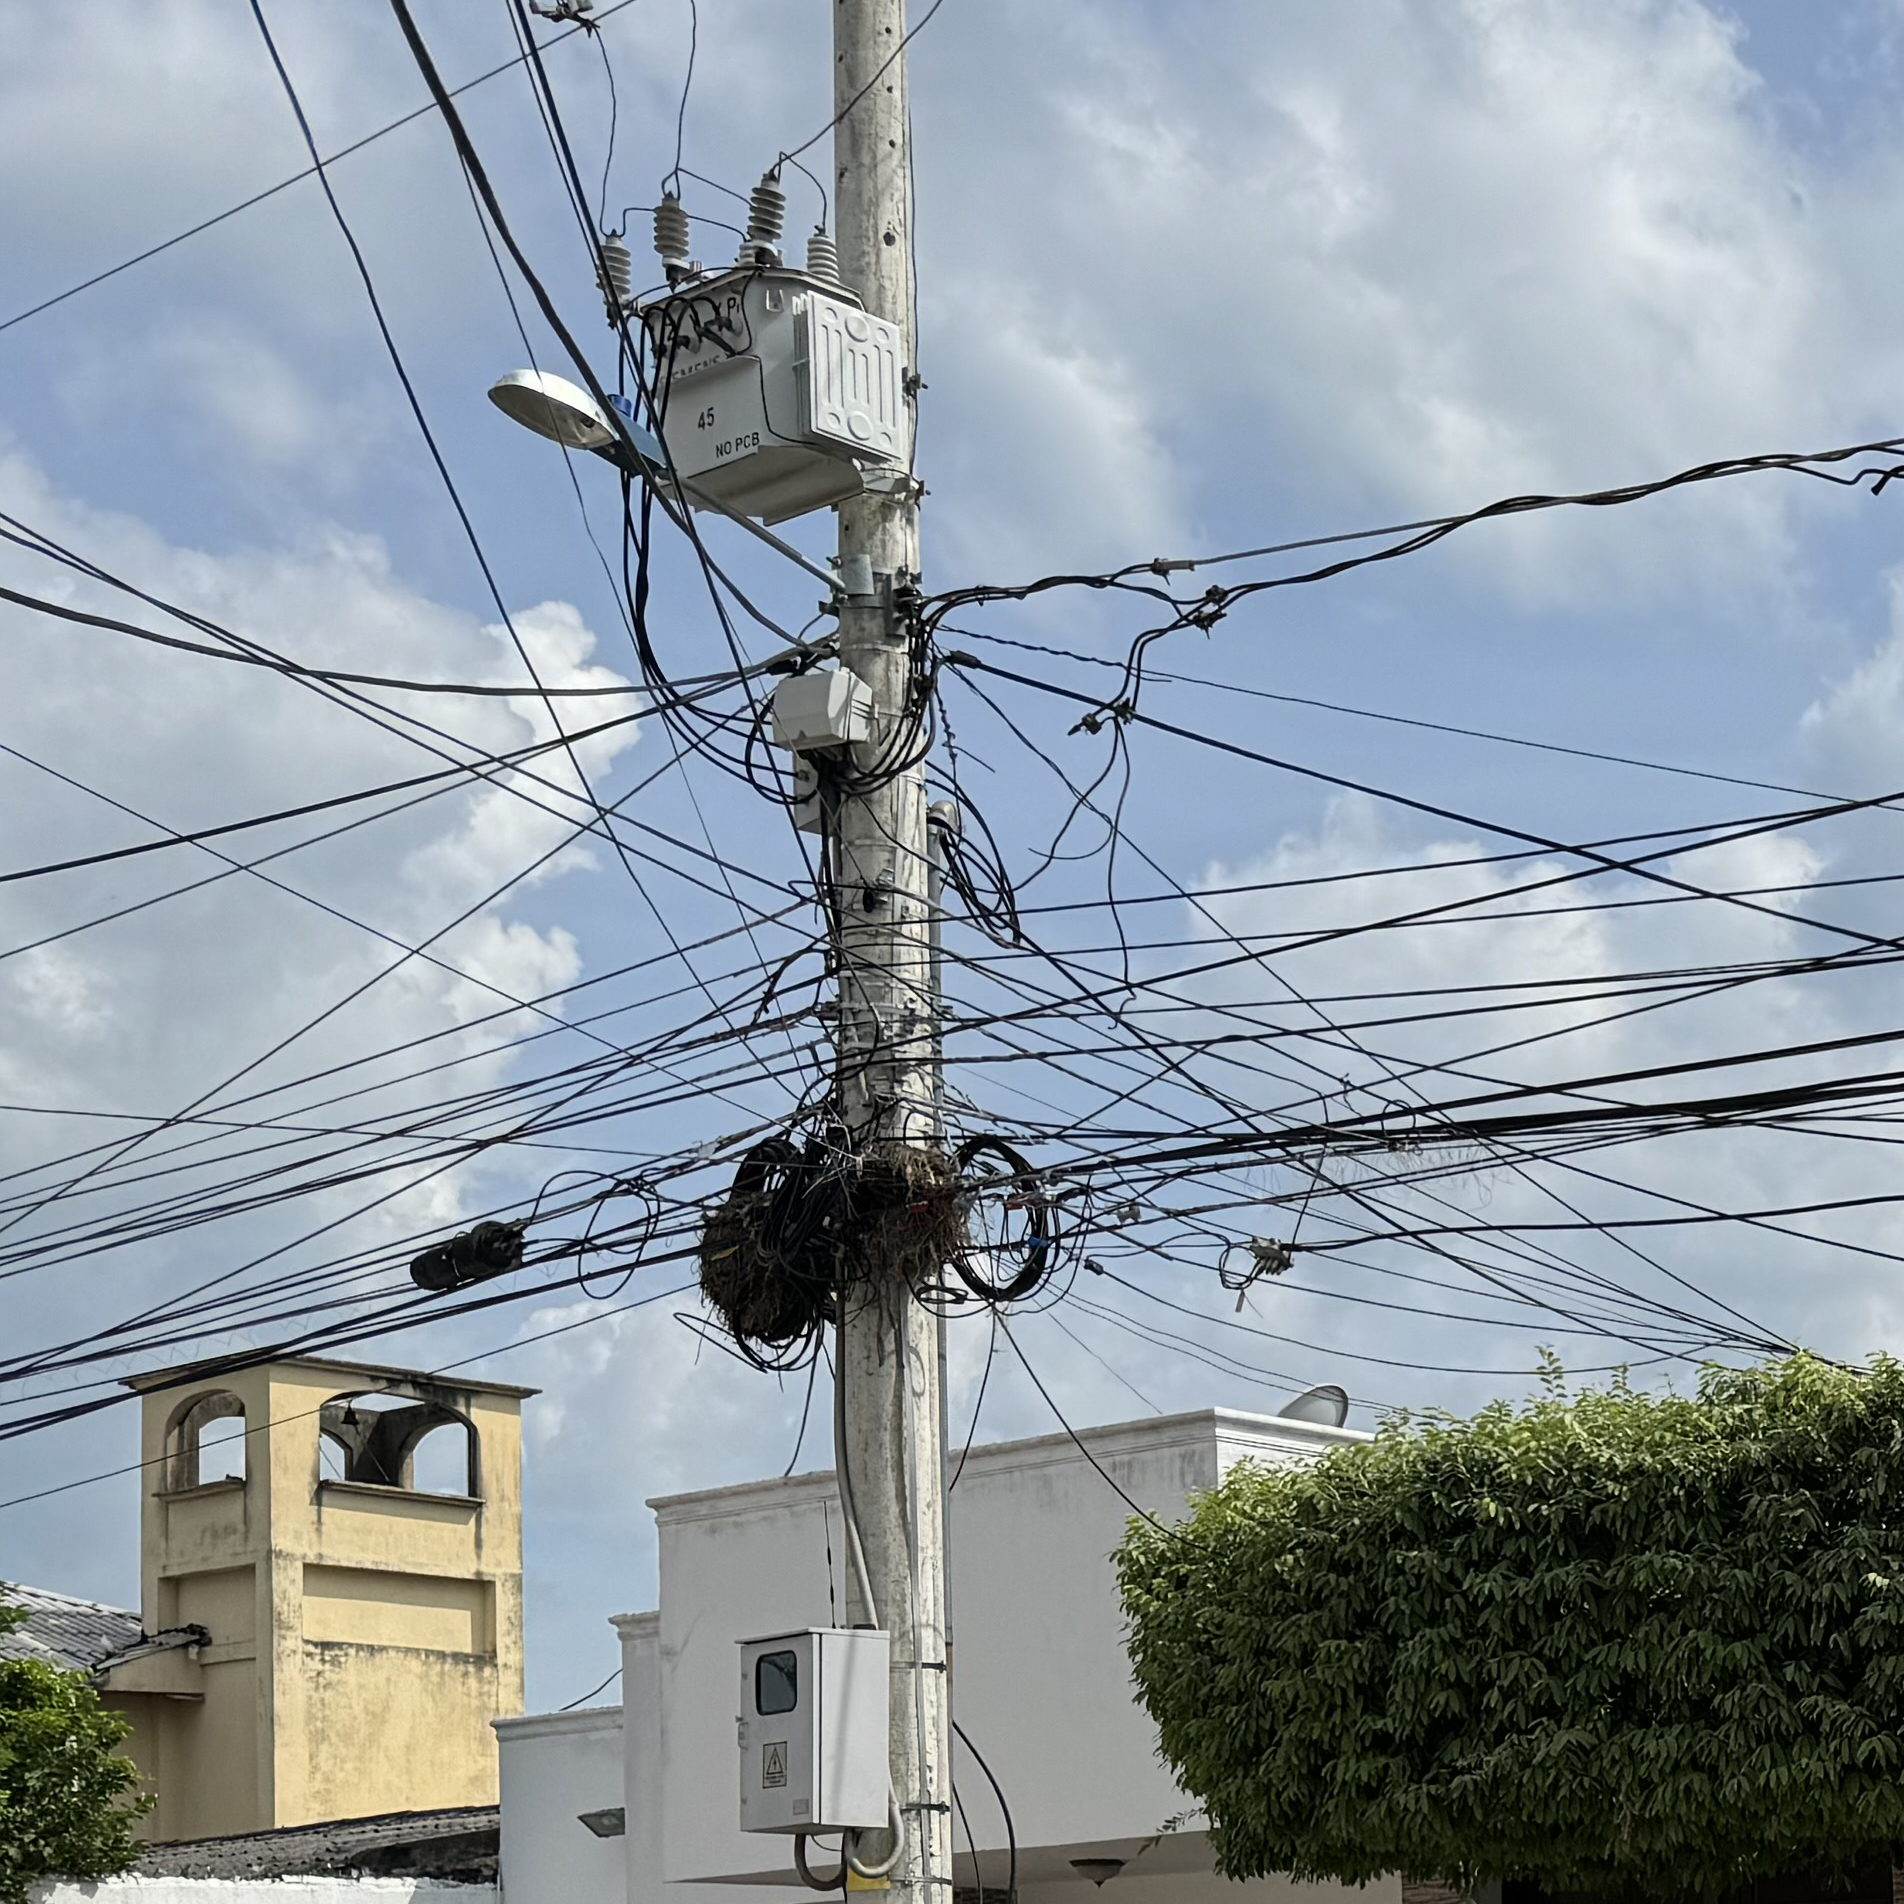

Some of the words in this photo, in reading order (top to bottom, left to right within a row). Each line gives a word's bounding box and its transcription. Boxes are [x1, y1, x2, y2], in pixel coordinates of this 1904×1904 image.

[697, 407, 715, 431] 45
[715, 441, 731, 458] NO
[735, 432, 760, 452] PCB
